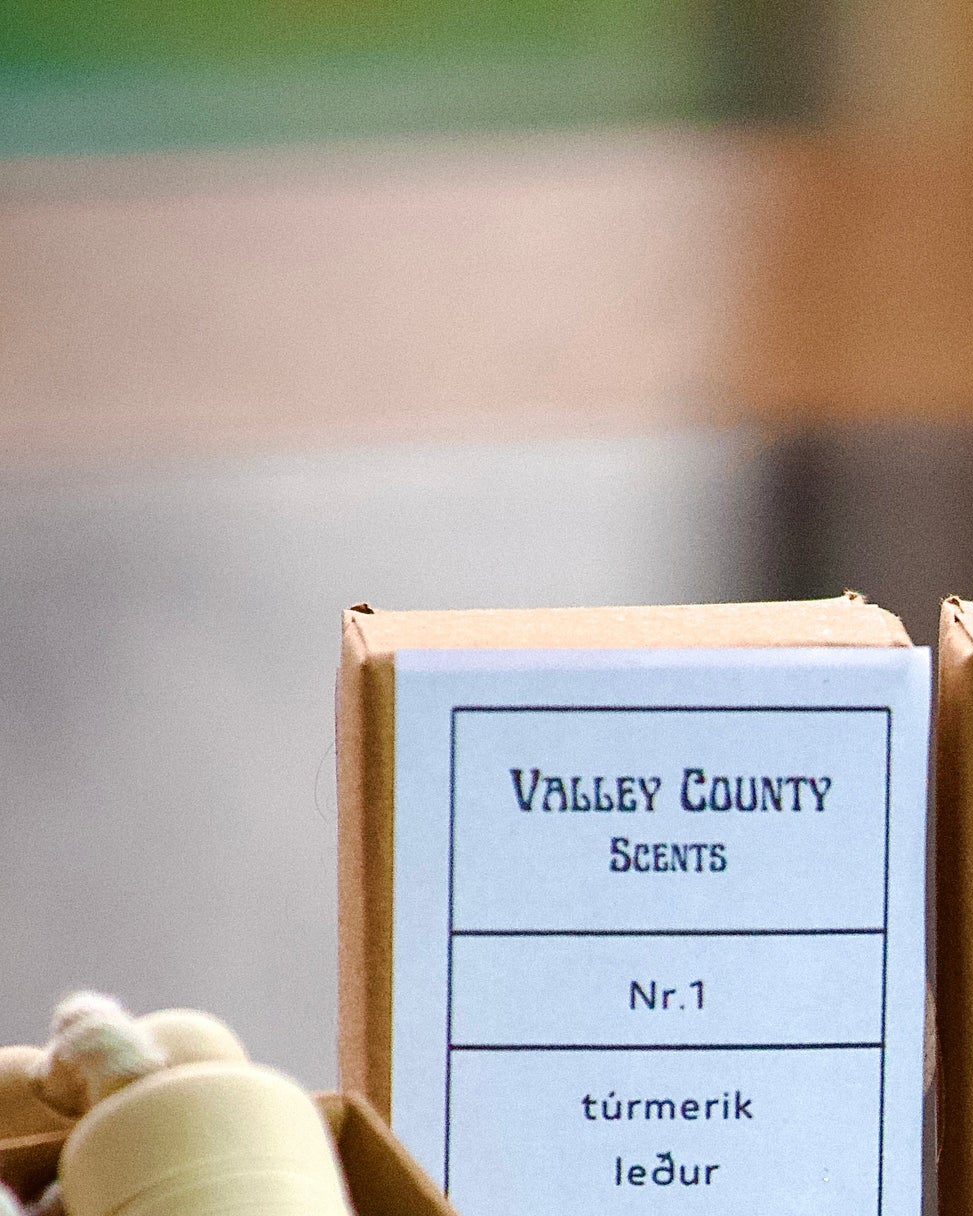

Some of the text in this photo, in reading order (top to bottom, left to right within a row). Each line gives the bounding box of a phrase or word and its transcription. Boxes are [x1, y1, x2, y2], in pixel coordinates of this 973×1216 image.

[510, 768, 832, 813] VALLEY COUNTY
[609, 836, 727, 873] SCENTS
[629, 980, 704, 1010] Nr.1
[581, 1090, 753, 1121] túrmerik
[615, 1151, 720, 1187] leður
